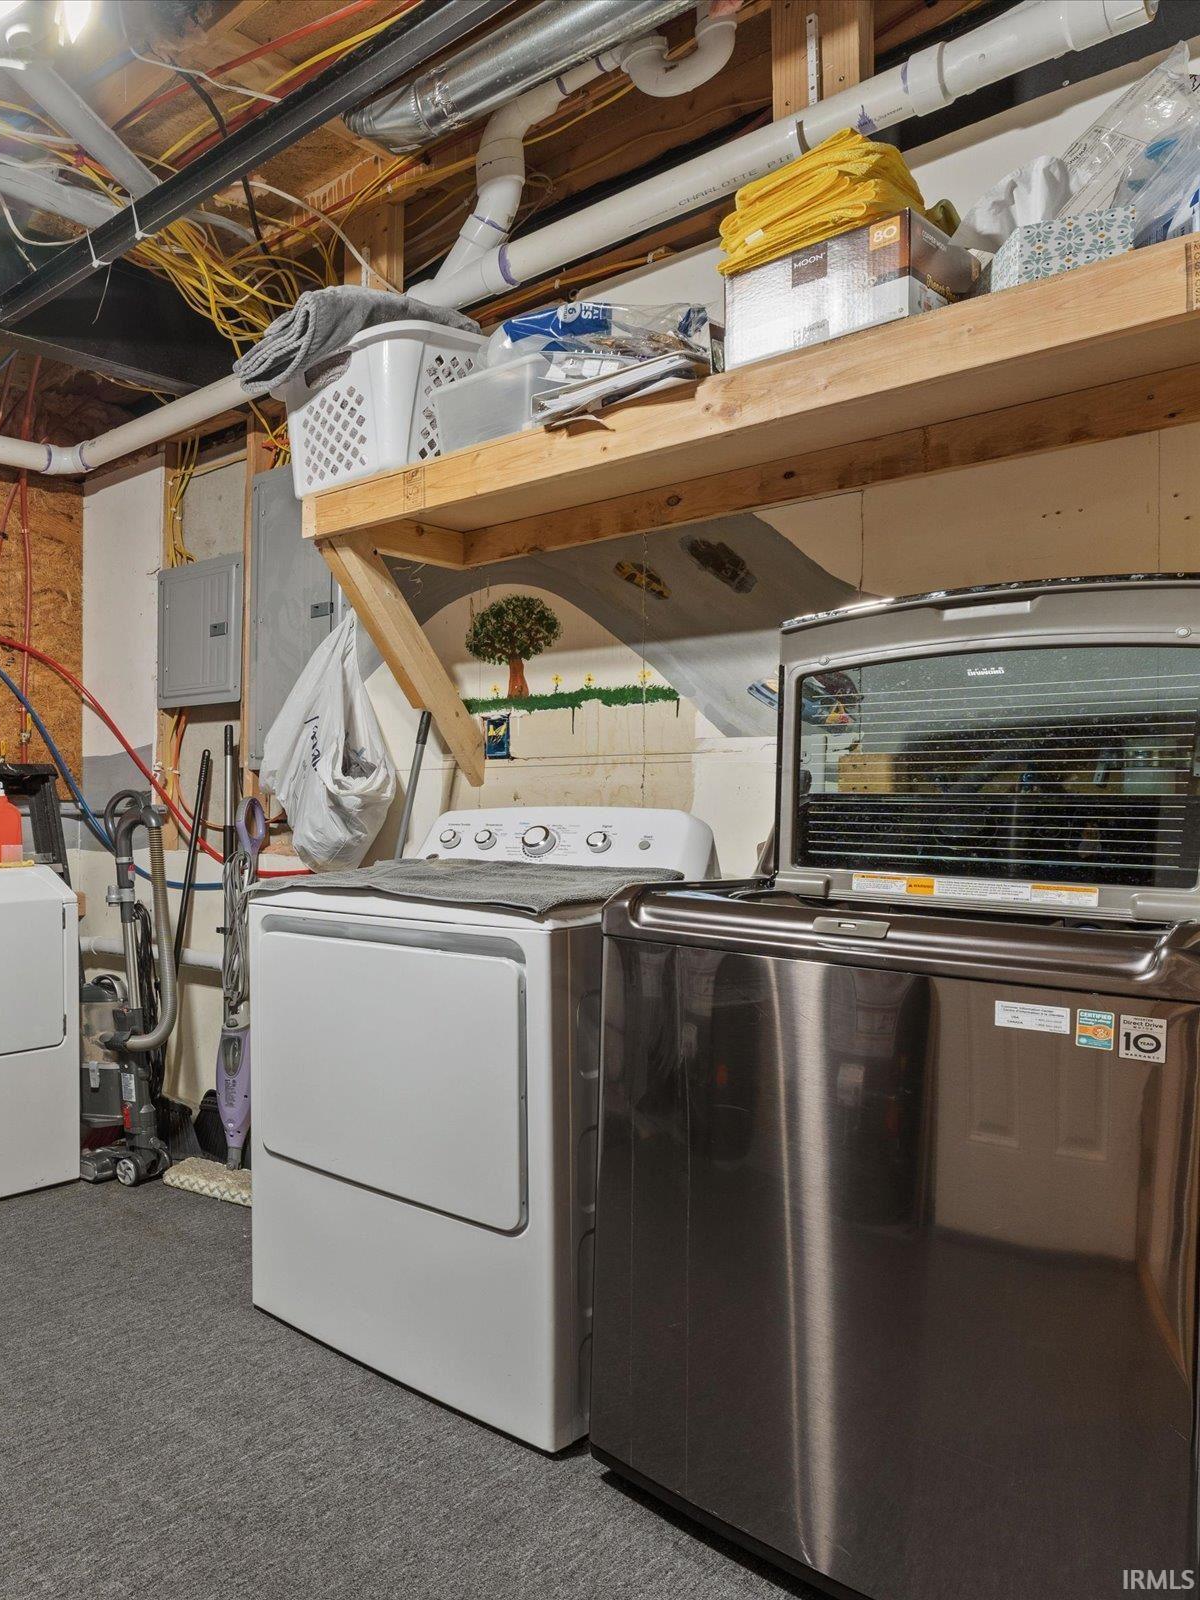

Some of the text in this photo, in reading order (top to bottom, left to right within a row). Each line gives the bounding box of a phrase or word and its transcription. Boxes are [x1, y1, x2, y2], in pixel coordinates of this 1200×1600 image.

[678, 152, 796, 206] CHARLOTTE PIP
[873, 224, 897, 243] 80
[793, 253, 824, 270] MOON
[1079, 1011, 1113, 1021] CERTIFIED
[1122, 1019, 1164, 1029] Direct Drive
[1123, 1031, 1162, 1054] 10
